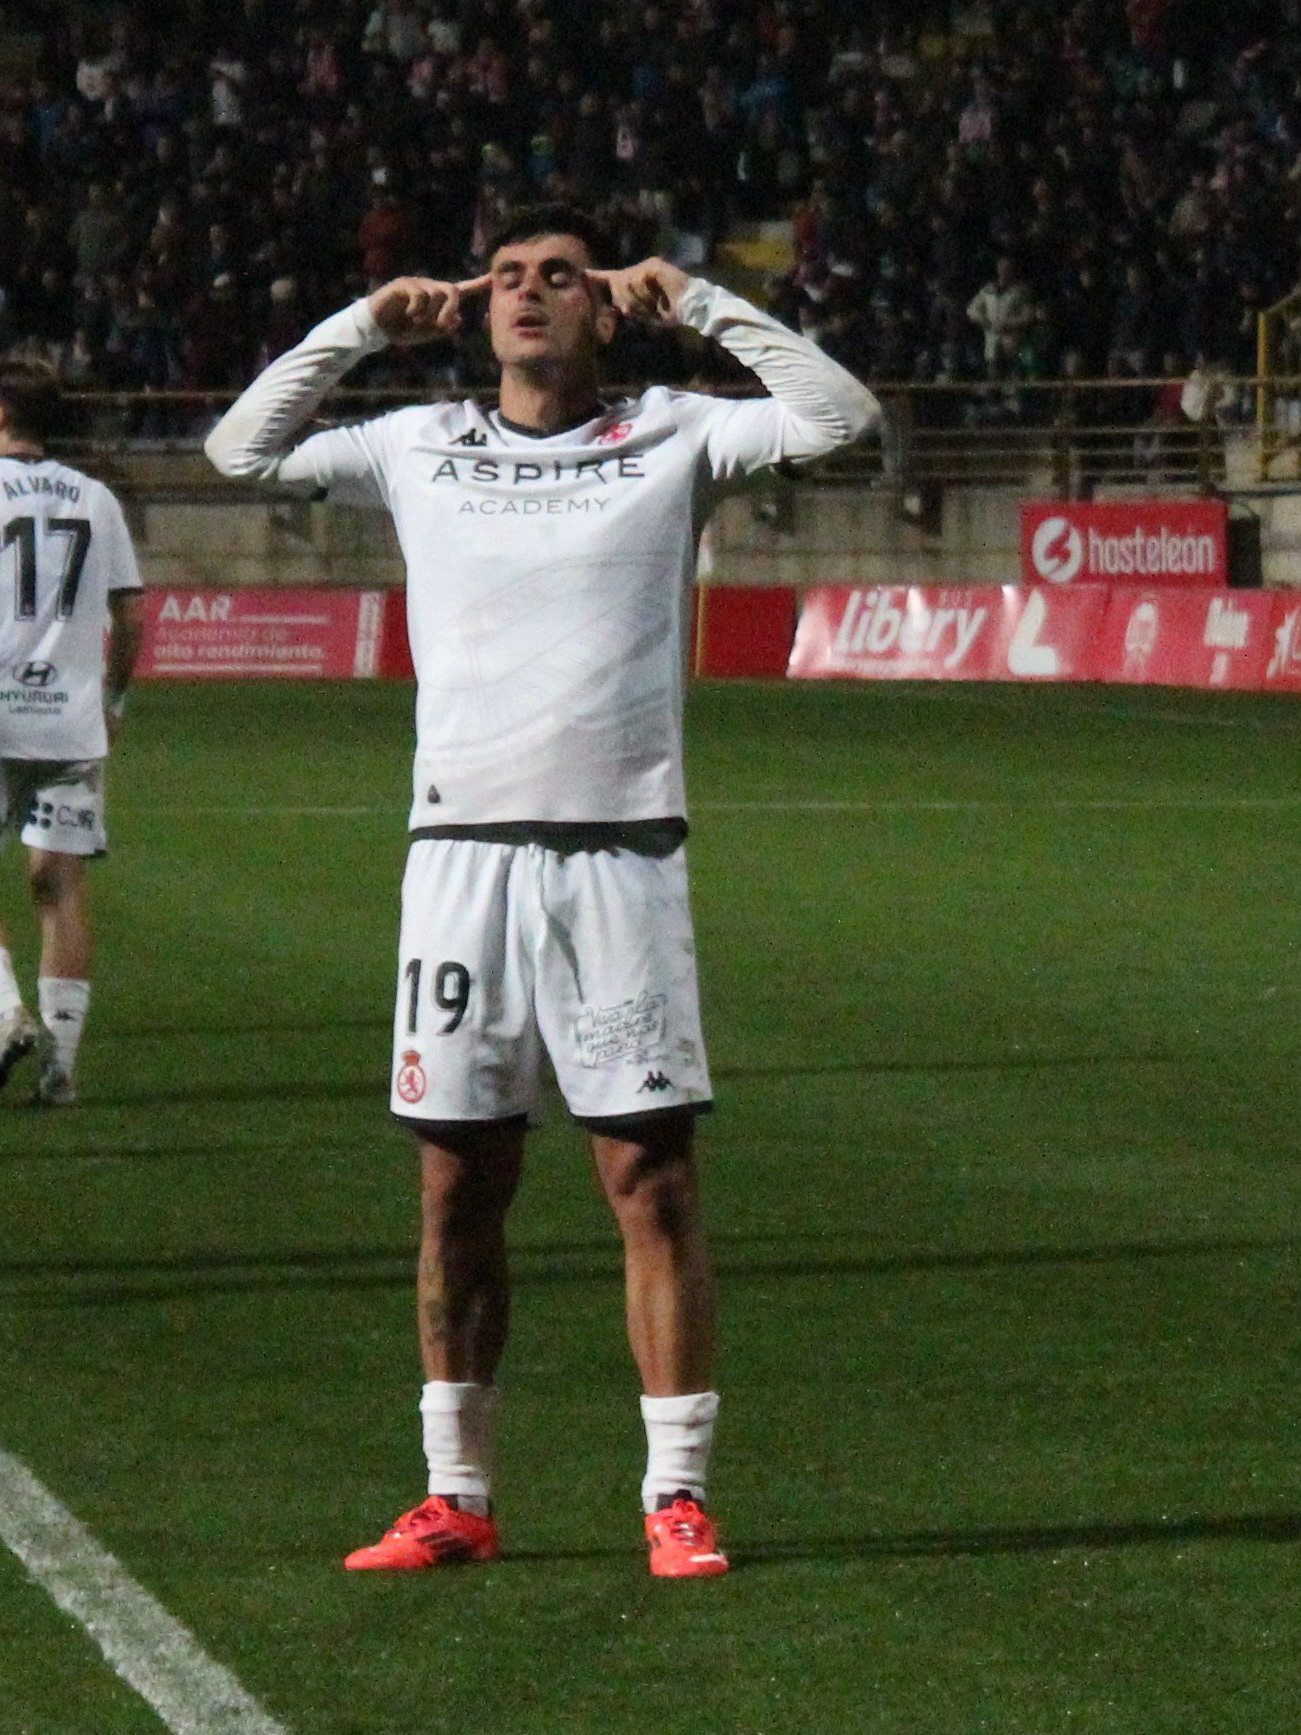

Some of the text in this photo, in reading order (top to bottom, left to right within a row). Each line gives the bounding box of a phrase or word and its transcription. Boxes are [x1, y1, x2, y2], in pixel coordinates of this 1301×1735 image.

[432, 454, 645, 484] ASPIRE
[459, 498, 611, 515] ACADEMY
[0, 517, 91, 621] 17
[159, 595, 231, 622] AAR
[405, 958, 470, 1037] 19
